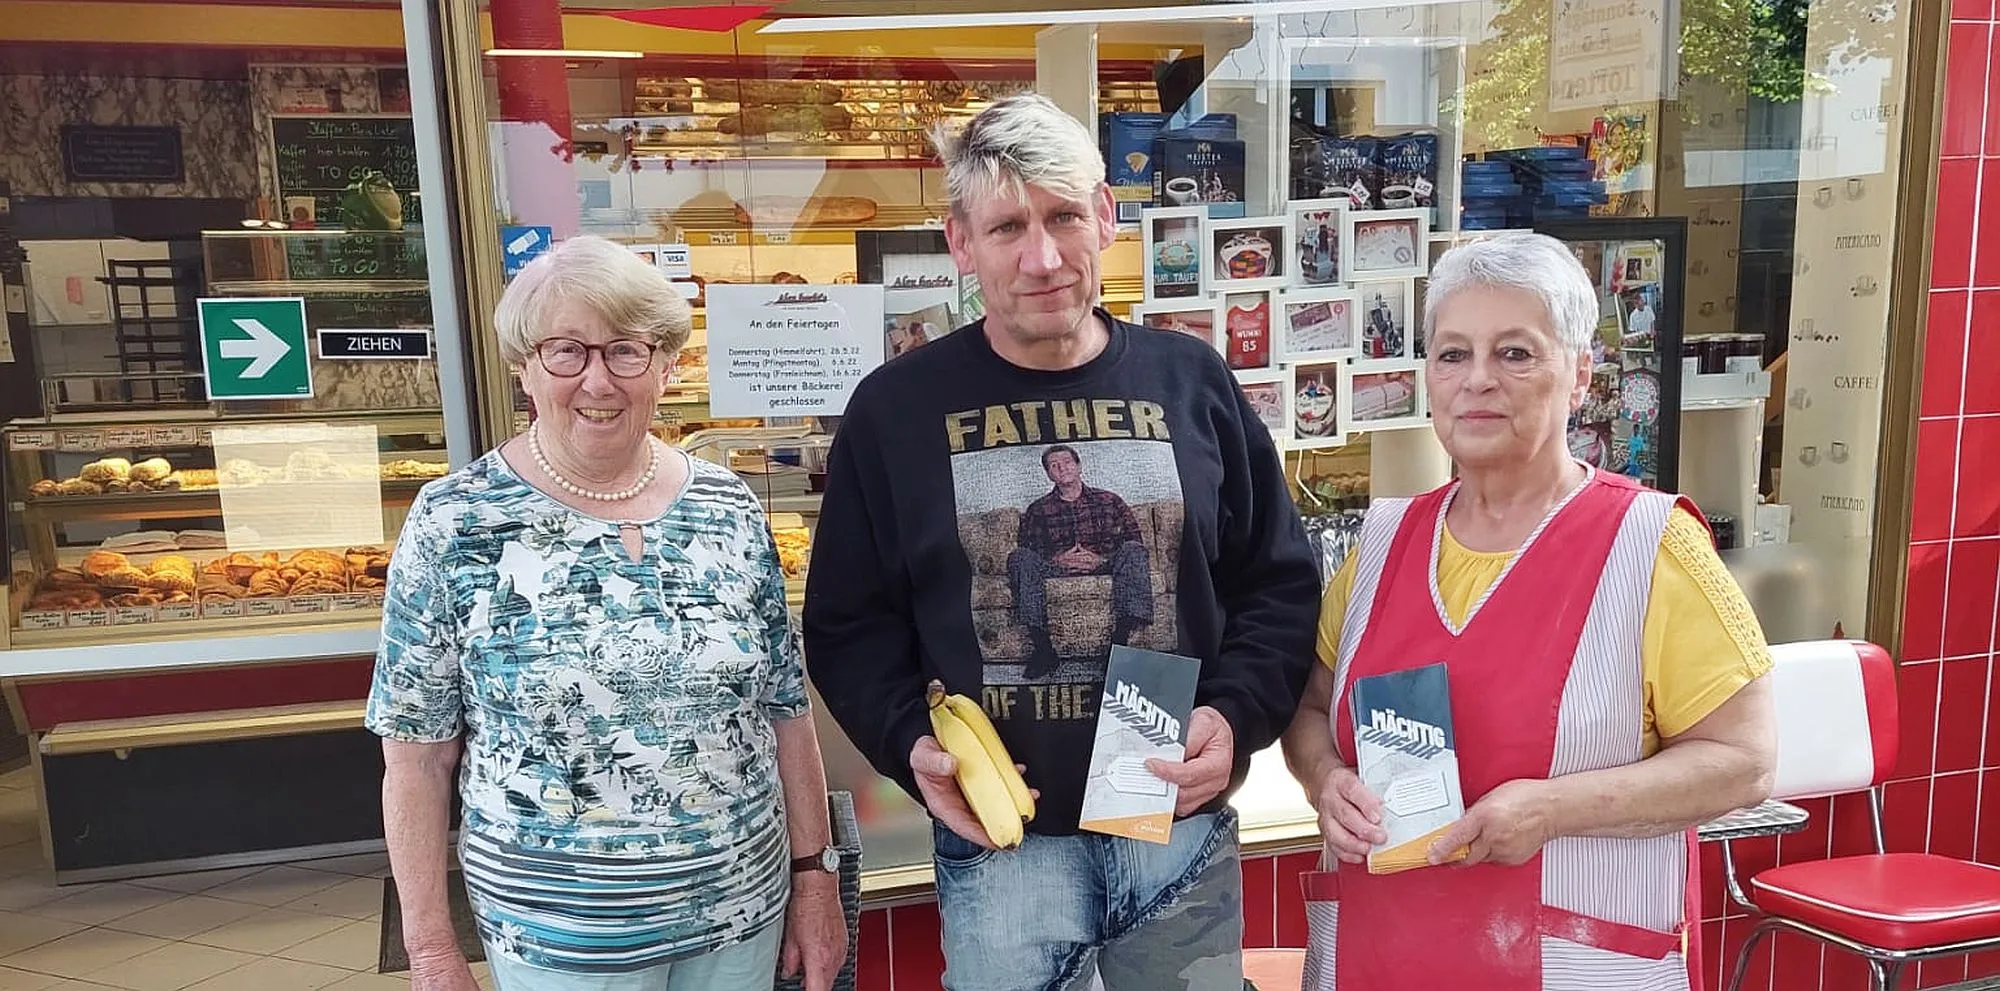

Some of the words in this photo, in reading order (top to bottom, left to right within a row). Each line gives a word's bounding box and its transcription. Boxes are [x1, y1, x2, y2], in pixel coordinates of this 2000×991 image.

[318, 165, 341, 179] TO
[348, 165, 371, 180] GO
[353, 259, 379, 274] GO
[750, 320, 762, 328] An
[766, 320, 783, 328] den
[787, 319, 840, 330] Feiertagen
[347, 337, 402, 351] ZIEHEN
[729, 348, 770, 357] Donnerstag
[732, 359, 760, 368] Montag
[750, 383, 762, 392] ist
[766, 384, 798, 392] unsere
[802, 382, 843, 391] Bäckerei
[1834, 376, 1874, 389] CAFFE
[769, 396, 825, 408] geschlossen
[945, 398, 1171, 452] FATHER
[981, 685, 1018, 720] OF
[1115, 680, 1181, 742] MÄCHTIG
[1103, 695, 1177, 748] UNFAIR
[1371, 708, 1445, 749] MÄCHTIG
[1362, 728, 1444, 760] UNFAIR
